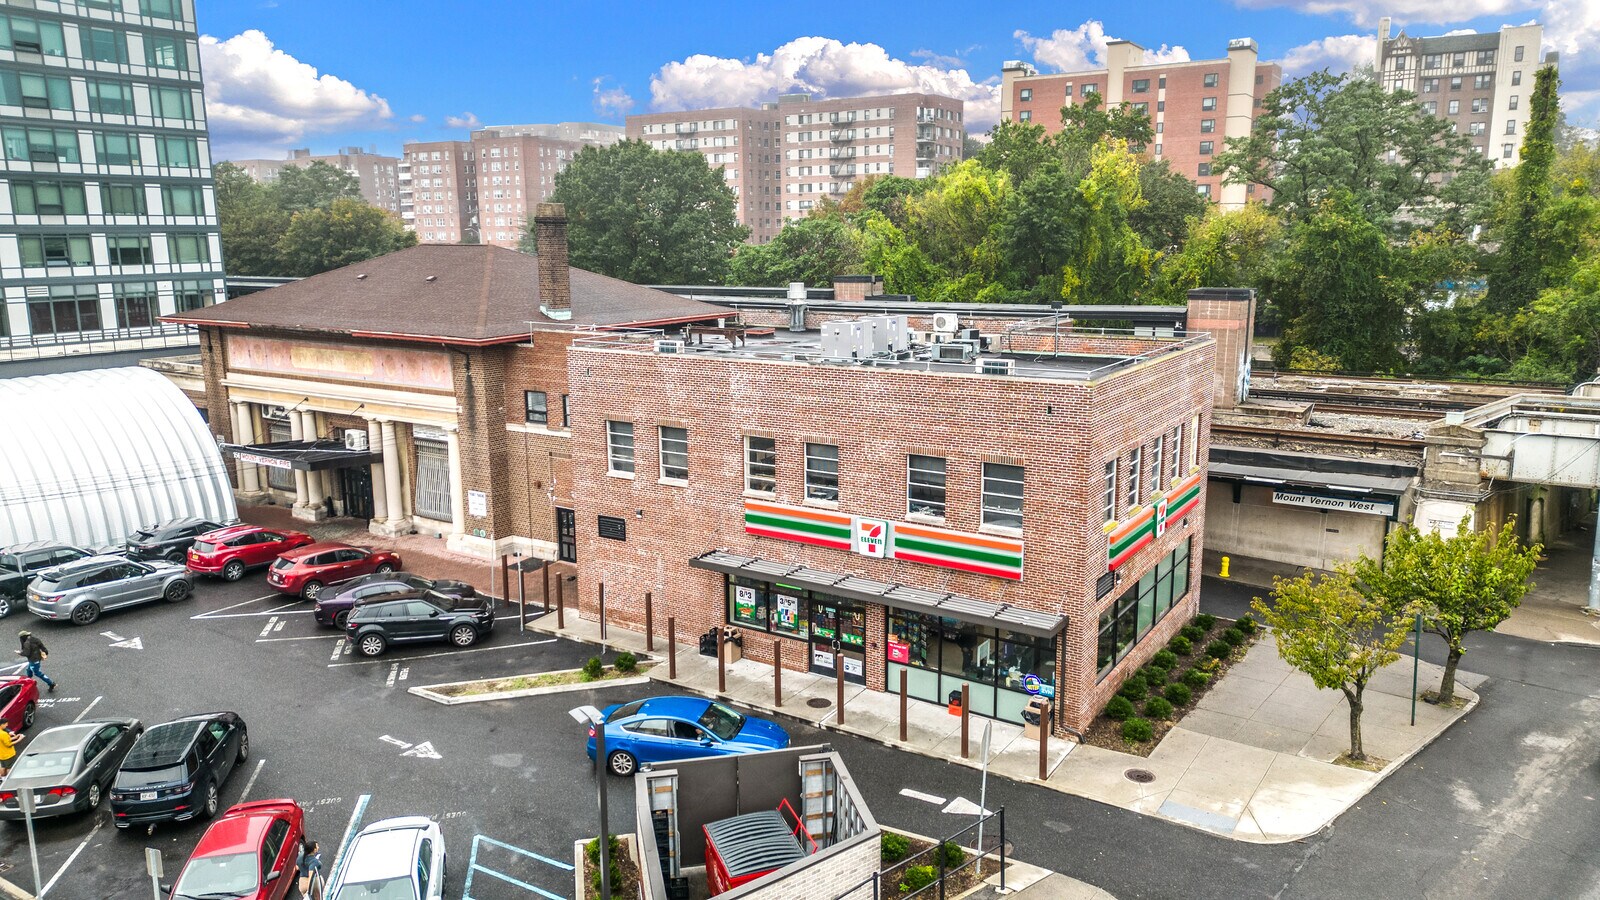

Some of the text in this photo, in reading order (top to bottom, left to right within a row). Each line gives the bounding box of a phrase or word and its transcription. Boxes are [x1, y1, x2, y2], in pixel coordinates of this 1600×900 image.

[1274, 493, 1374, 510] Mount Vernon West
[316, 797, 342, 805] GUEST
